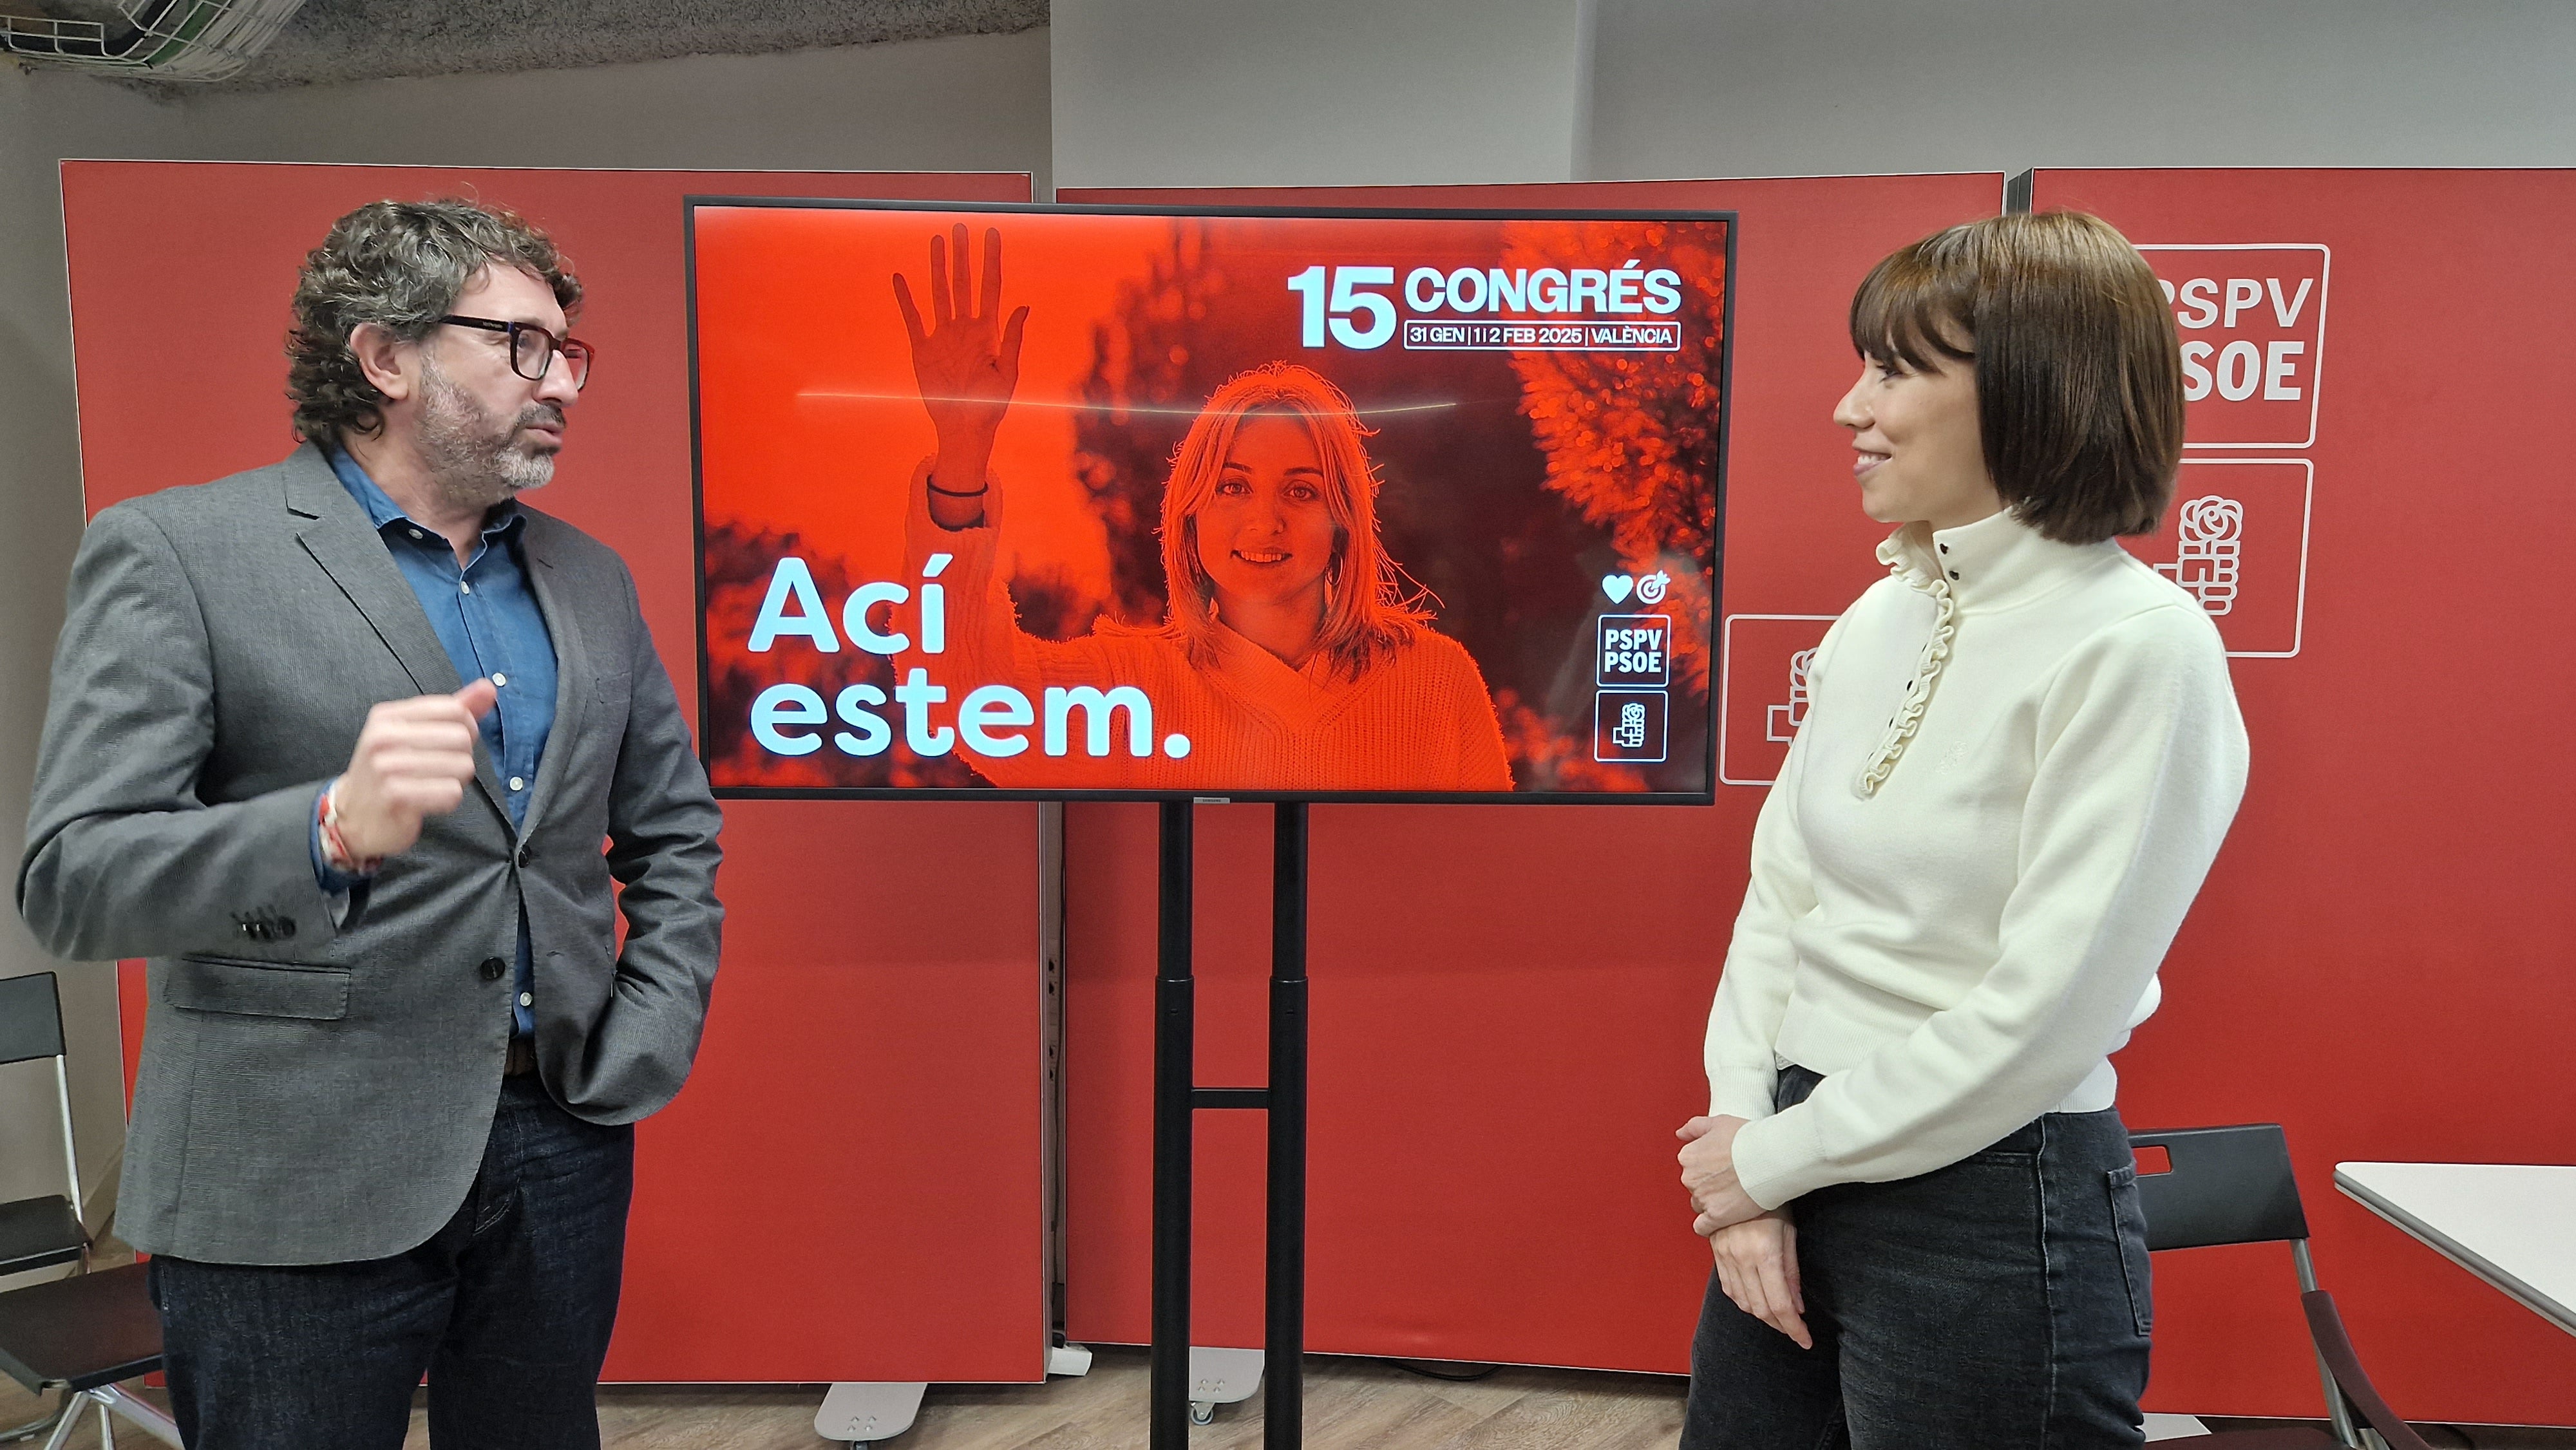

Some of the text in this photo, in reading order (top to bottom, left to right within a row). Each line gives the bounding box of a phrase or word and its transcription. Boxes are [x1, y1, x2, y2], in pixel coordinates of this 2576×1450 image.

[1287, 259, 1682, 349] 15 CONGRÉS
[1410, 326, 1673, 344] 31 GEN 1 i 2 FEB 2025 VALÈNCIA
[2179, 340, 2305, 400] SOE
[748, 553, 953, 654] Ací
[1604, 652, 1662, 673] PSOE
[1605, 629, 1662, 650] PSPV
[750, 668, 1191, 758] estem.
